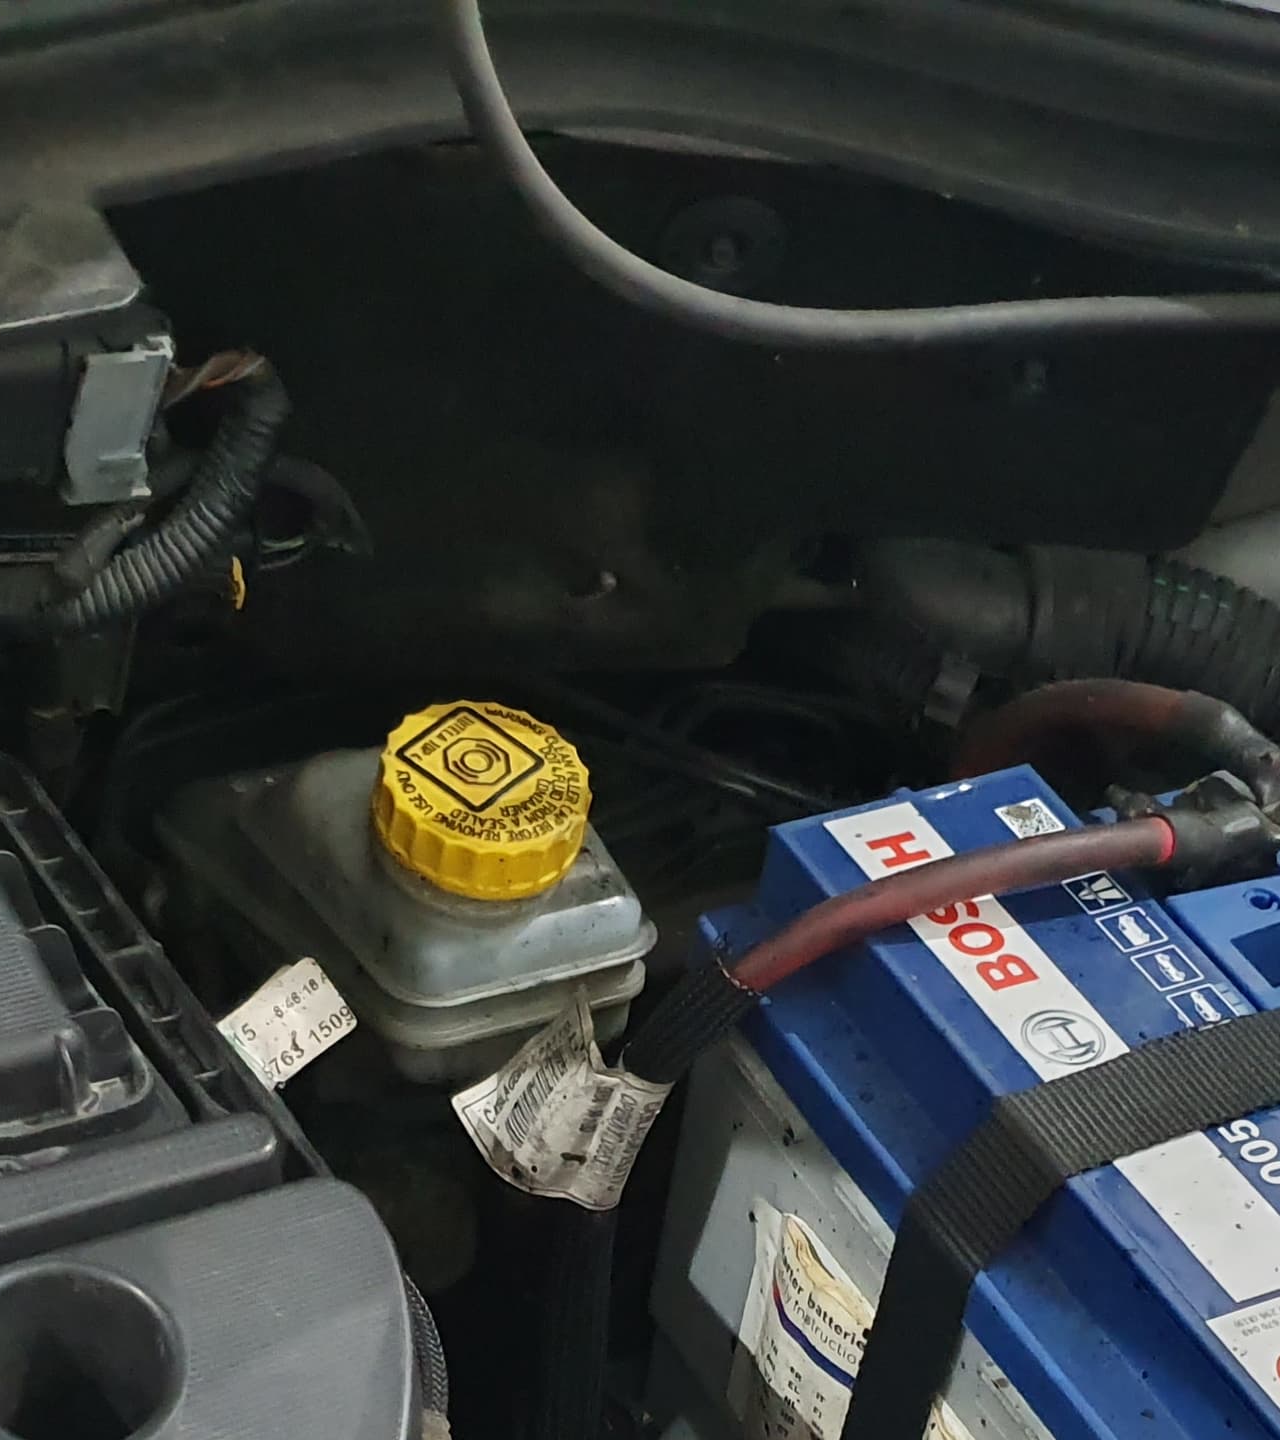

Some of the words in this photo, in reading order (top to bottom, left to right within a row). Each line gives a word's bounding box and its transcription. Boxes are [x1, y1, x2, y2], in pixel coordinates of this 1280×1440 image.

[396, 769, 417, 794] ONLY
[565, 771, 581, 805] FILLER
[409, 793, 434, 816] USE
[499, 778, 552, 817] CONTAINER
[432, 811, 501, 842] REMOVING
[450, 808, 507, 830] SEALED
[511, 816, 521, 827] A
[524, 802, 557, 826] FROM
[505, 820, 554, 843] BEFORE
[865, 831, 1040, 991] BOSH
[309, 1006, 354, 1045] 1509
[793, 1300, 857, 1365] instructio
[807, 1291, 866, 1350] batterie
